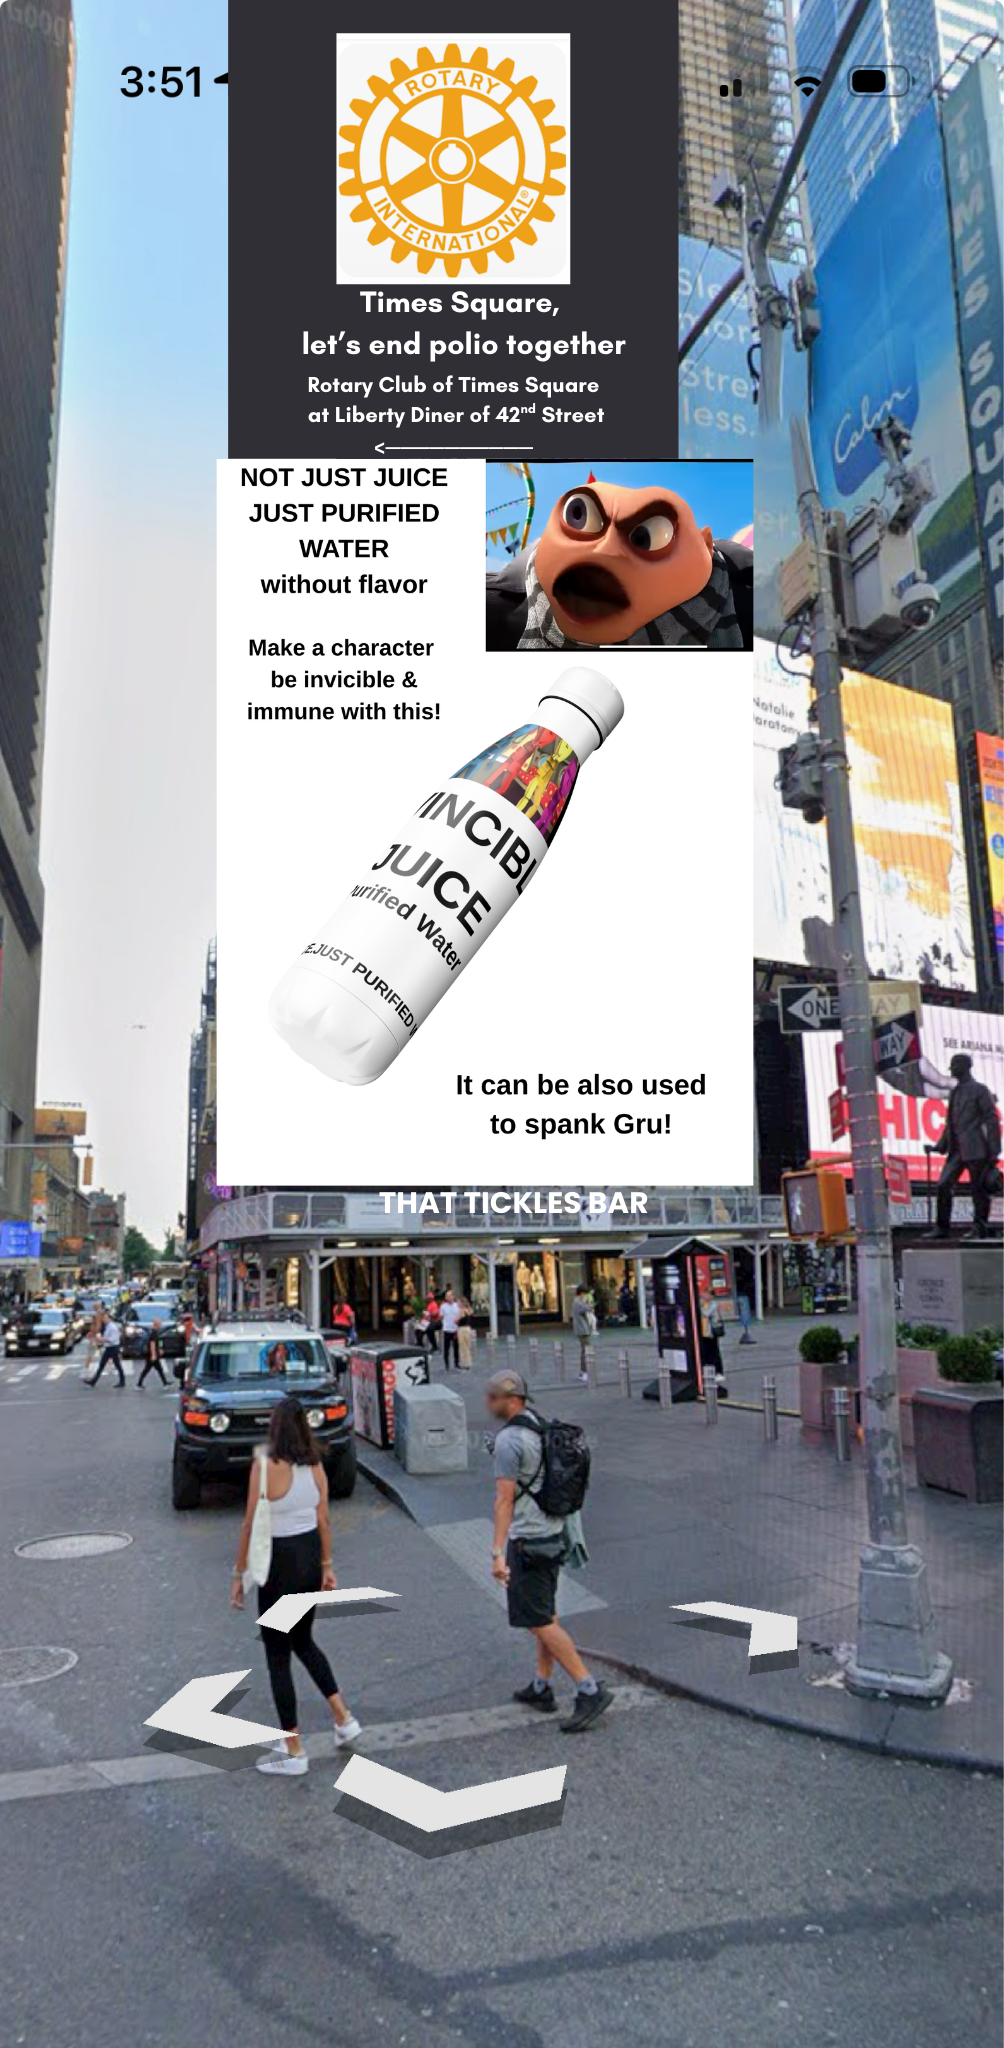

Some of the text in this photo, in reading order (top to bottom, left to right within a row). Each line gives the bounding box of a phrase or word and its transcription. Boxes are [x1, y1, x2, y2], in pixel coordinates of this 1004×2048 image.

[680, 359, 749, 399] Stre
[834, 384, 913, 465] Calm
[753, 697, 796, 720] Natalie
[802, 994, 901, 1018] ONE AY
